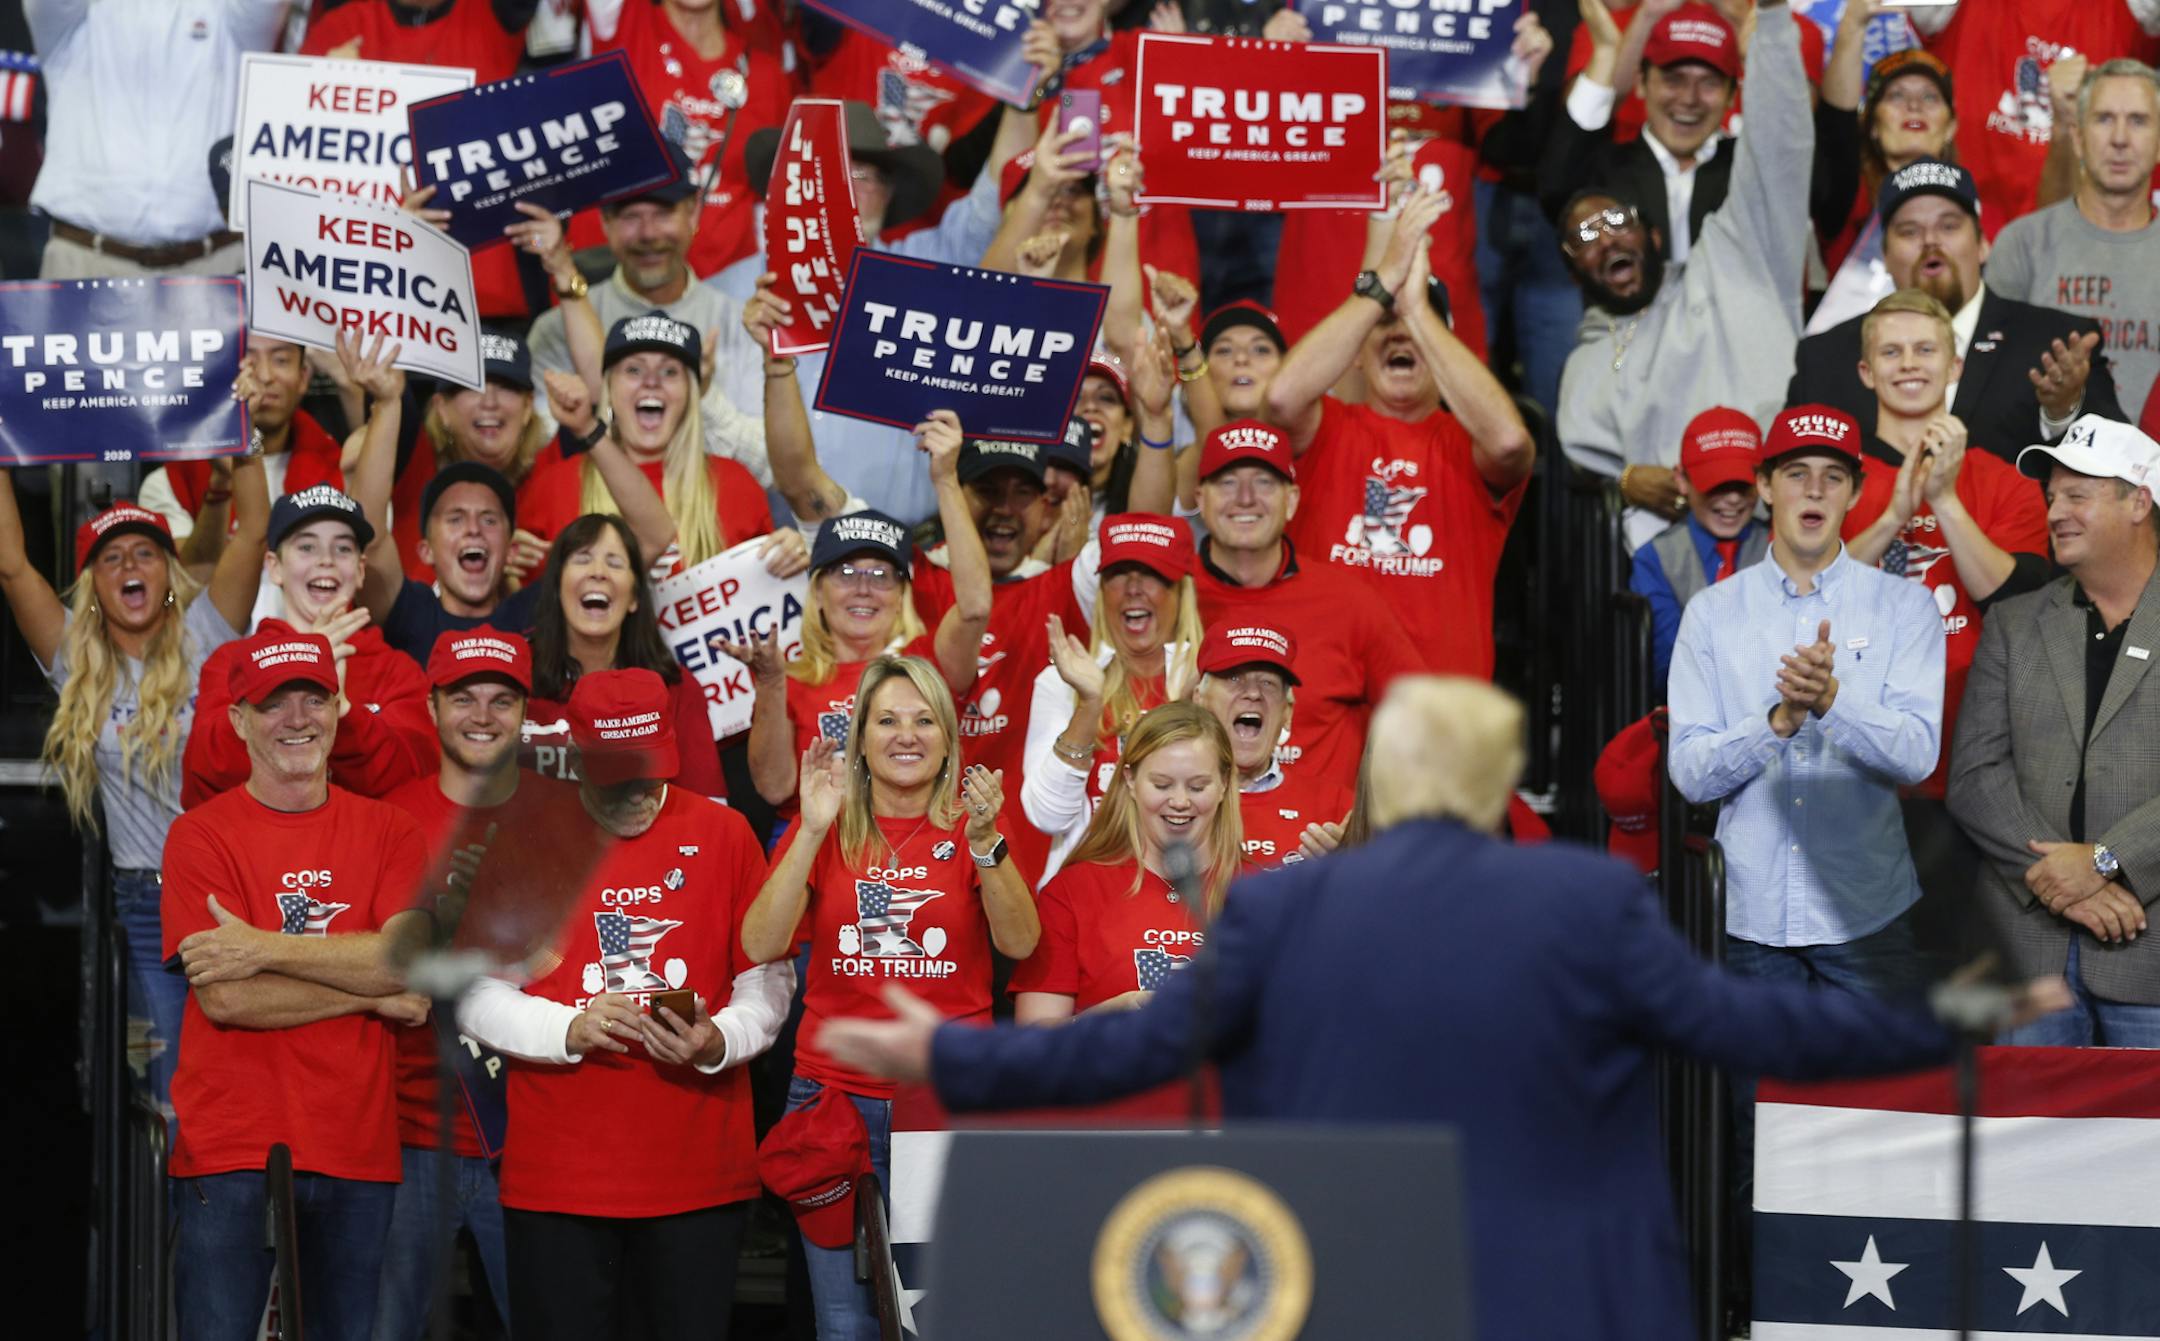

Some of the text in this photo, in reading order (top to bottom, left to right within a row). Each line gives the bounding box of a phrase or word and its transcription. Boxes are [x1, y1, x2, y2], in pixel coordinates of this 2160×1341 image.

[1323, 5, 1493, 40] PENCE
[308, 81, 398, 114] KEEP
[1153, 83, 1366, 123] TRUMP
[249, 122, 413, 166] AMERIC
[426, 101, 627, 181] TRUMP
[1171, 121, 1346, 147] PENCE
[450, 133, 620, 202] PENCE
[1188, 148, 1221, 160] KEEP
[1223, 149, 1280, 162] AMERICA
[509, 174, 565, 200] AMERICA
[318, 214, 414, 253] KEEP
[801, 139, 840, 313] PENCE
[261, 241, 468, 324] AMERICA
[277, 286, 458, 352] WORKING
[863, 301, 1075, 360] TRUMP
[2, 328, 225, 367] TRUMP
[873, 339, 1047, 383] PENCE
[24, 366, 205, 393] PENCE
[885, 367, 1026, 398] KEEP AMERICA GREAT!
[42, 393, 189, 410] KEEP AMERICA GREAT!
[1787, 414, 1850, 433] TRUMP
[1218, 428, 1279, 445] TRUMP
[2065, 425, 2096, 448] SA
[103, 450, 133, 462] 2020
[832, 517, 905, 541] AMERICAN
[838, 529, 898, 550] WORKER
[1329, 543, 1444, 577] FOR TRUMP
[656, 578, 740, 631] KEEP
[674, 592, 804, 673] ERICA
[1226, 627, 1289, 649] MAKE AMERICA
[251, 642, 321, 662] MAKE AMERICA
[451, 638, 518, 656] MAKE AMERICA
[456, 647, 513, 664] GREAT AGAIN
[1231, 636, 1287, 656] GREAT AGAIN
[259, 652, 319, 669] GREAT AGAIN
[593, 711, 661, 729] MAKE AMERICA
[600, 723, 659, 740] GREAT AGAIN
[535, 746, 579, 781] PI
[1240, 840, 1276, 855] PS
[866, 866, 928, 880] COPS
[601, 885, 663, 906] COPS
[1143, 928, 1205, 946] COPS
[831, 958, 958, 978] FOR TRUMP
